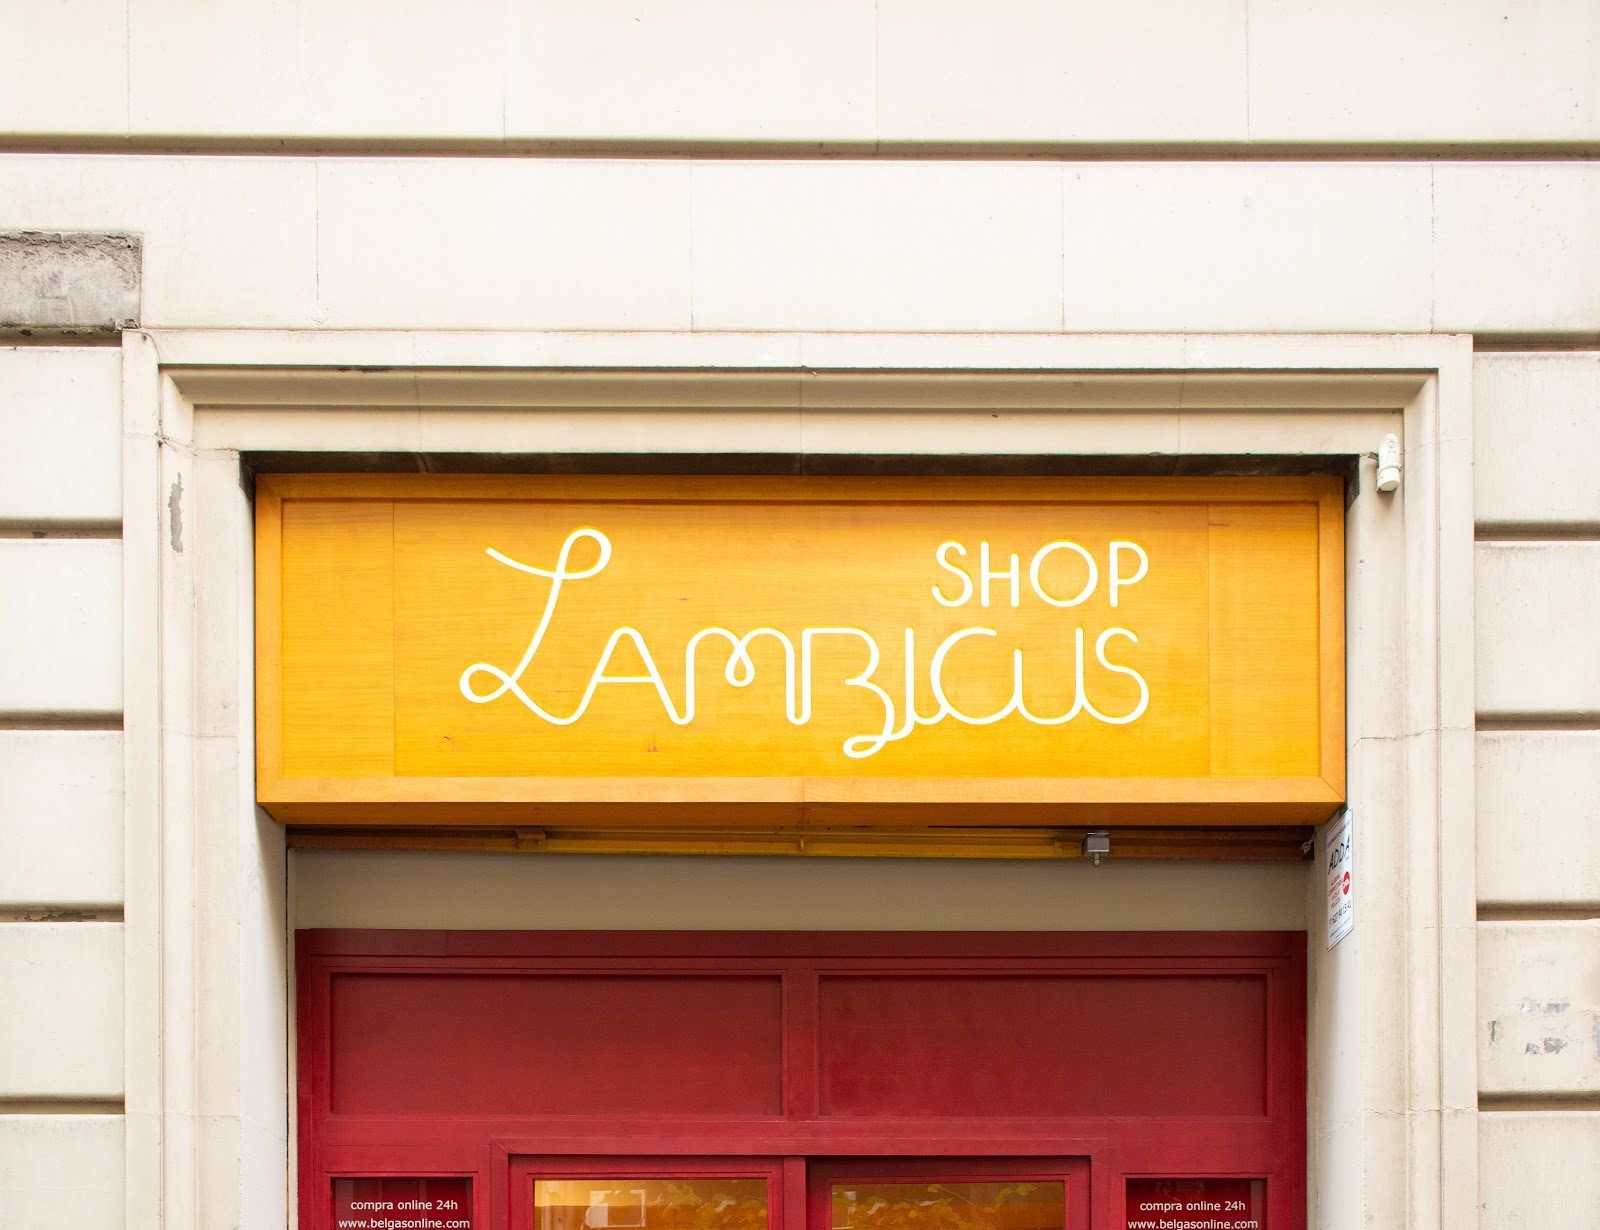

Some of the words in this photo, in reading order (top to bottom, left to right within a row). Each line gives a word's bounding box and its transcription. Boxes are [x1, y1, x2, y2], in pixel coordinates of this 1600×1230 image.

[930, 540, 1149, 608] SHOP
[350, 1201, 394, 1212] compra
[397, 1199, 433, 1210] online
[436, 1200, 458, 1210] 24h
[1139, 1202, 1183, 1213] compra
[1186, 1200, 1221, 1211] online
[1224, 1200, 1246, 1211] 24h
[338, 1217, 471, 1230] www.belgasonline.com
